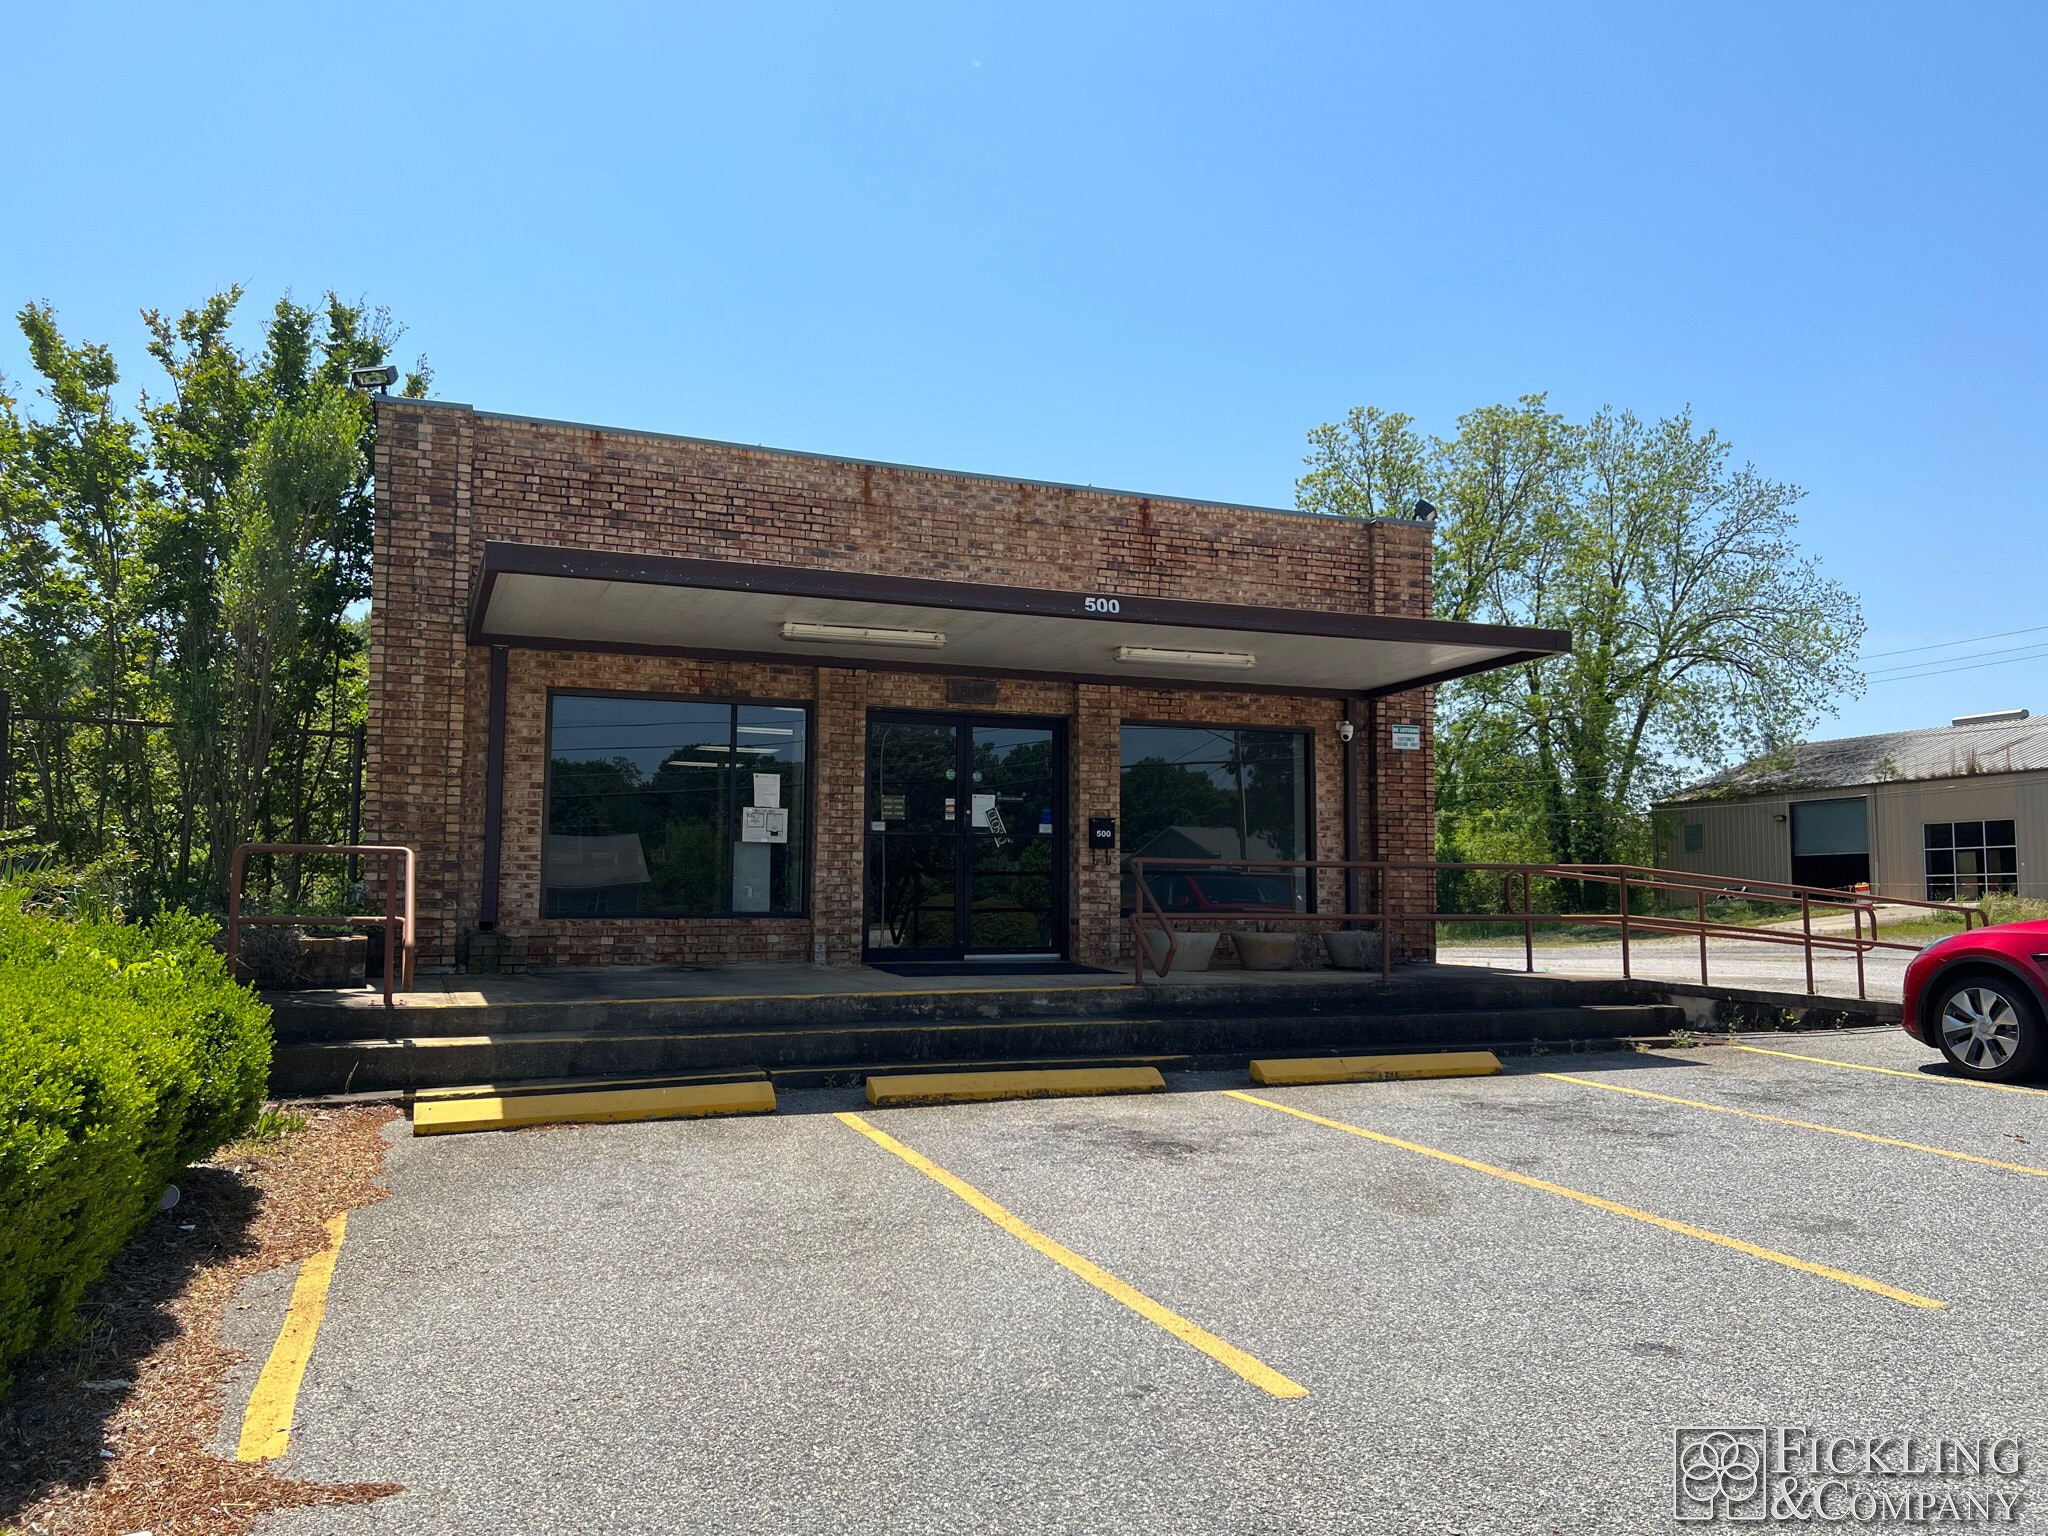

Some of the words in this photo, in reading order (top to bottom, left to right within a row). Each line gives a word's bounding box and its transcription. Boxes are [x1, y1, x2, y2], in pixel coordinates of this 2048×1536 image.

[1084, 597, 1120, 614] 500
[987, 809, 1007, 845] CLOSD
[1096, 830, 1112, 838] 500
